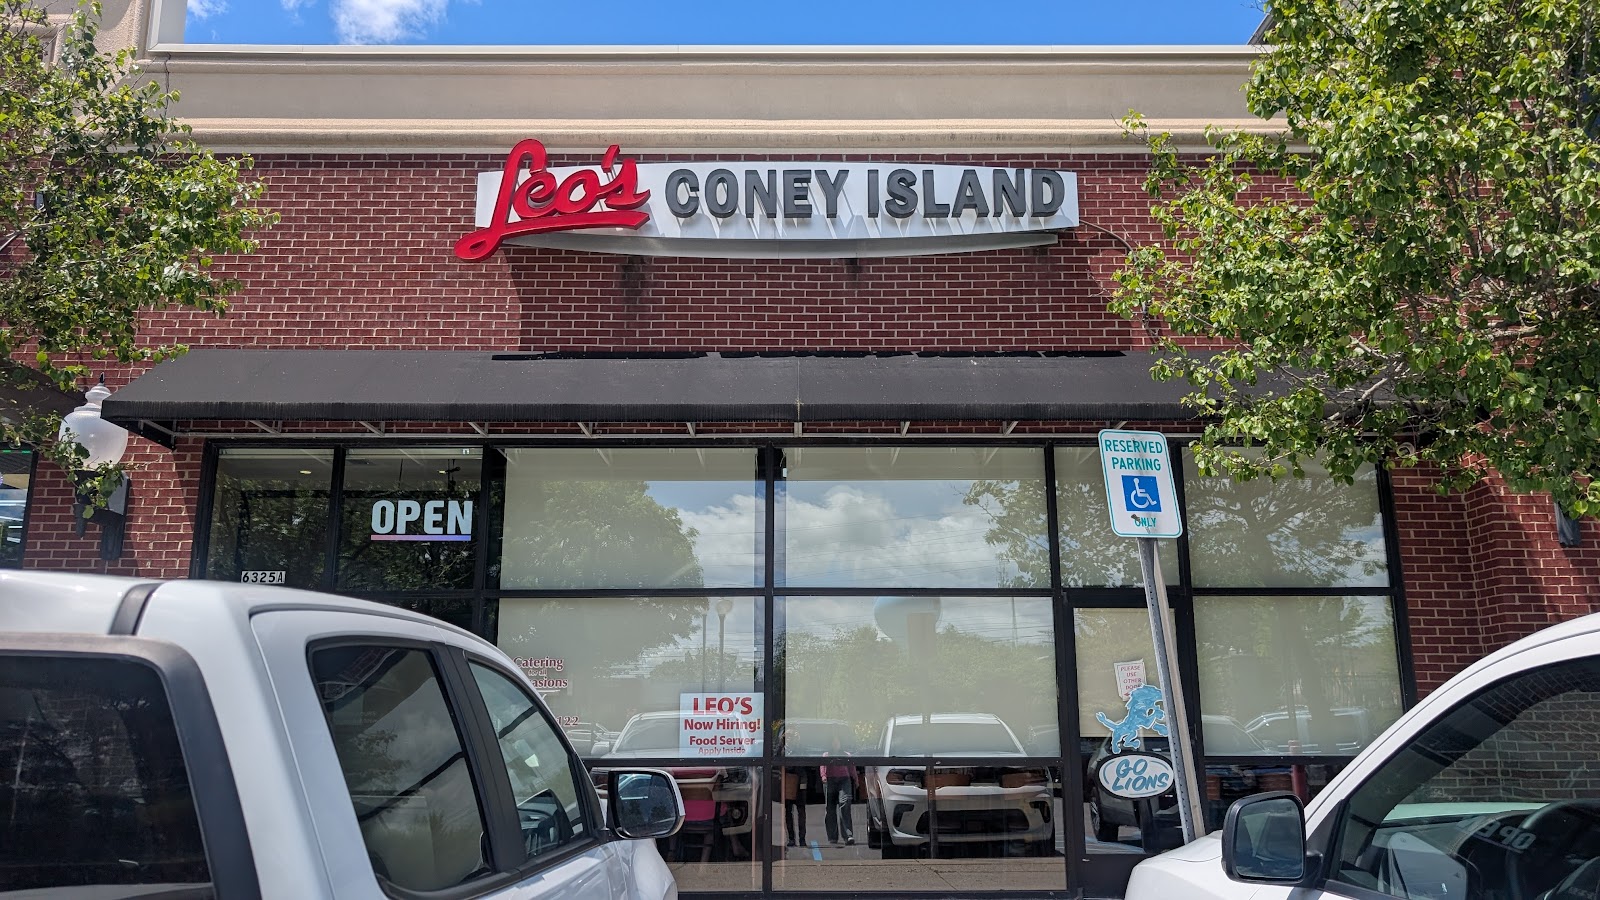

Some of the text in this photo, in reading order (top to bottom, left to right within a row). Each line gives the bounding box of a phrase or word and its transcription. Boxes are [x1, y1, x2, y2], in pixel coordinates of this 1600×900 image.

[454, 139, 1065, 261] Leo's CONEY ISLAND
[1105, 440, 1163, 454] RESERVED
[1112, 457, 1161, 471] PARKING
[371, 500, 474, 535] OPEN
[1134, 517, 1157, 527] ONLY
[242, 572, 284, 583] 6325A
[514, 656, 564, 671] Catering
[531, 676, 568, 688] asions
[693, 697, 753, 715] LEO'S
[684, 718, 761, 733] Now Hiring!
[689, 735, 755, 746] Food Server
[698, 747, 721, 755] Apply
[1116, 759, 1148, 778] GO
[1112, 772, 1169, 791] LIONS
